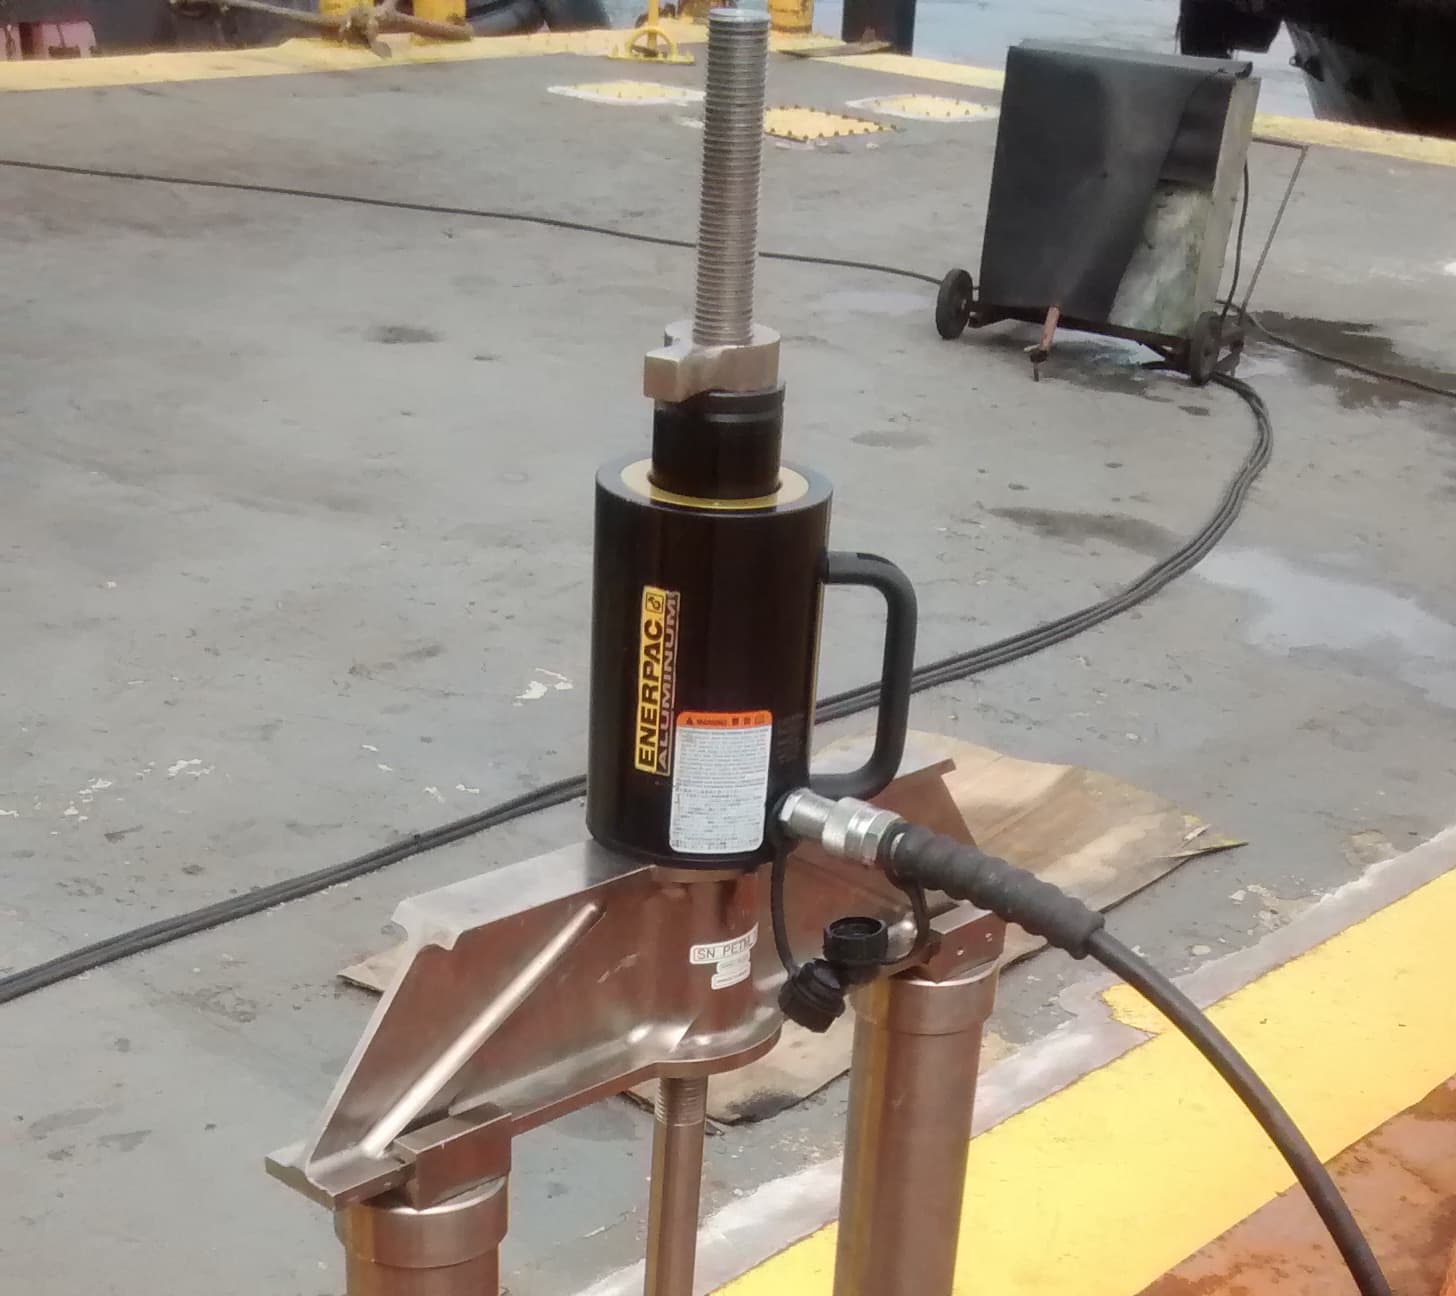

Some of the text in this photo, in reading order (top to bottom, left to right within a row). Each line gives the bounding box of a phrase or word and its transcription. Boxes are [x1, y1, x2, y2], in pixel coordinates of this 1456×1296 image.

[639, 618, 663, 767] ENERPAC
[658, 599, 676, 770] ALUMINUM
[697, 947, 715, 960] SN
